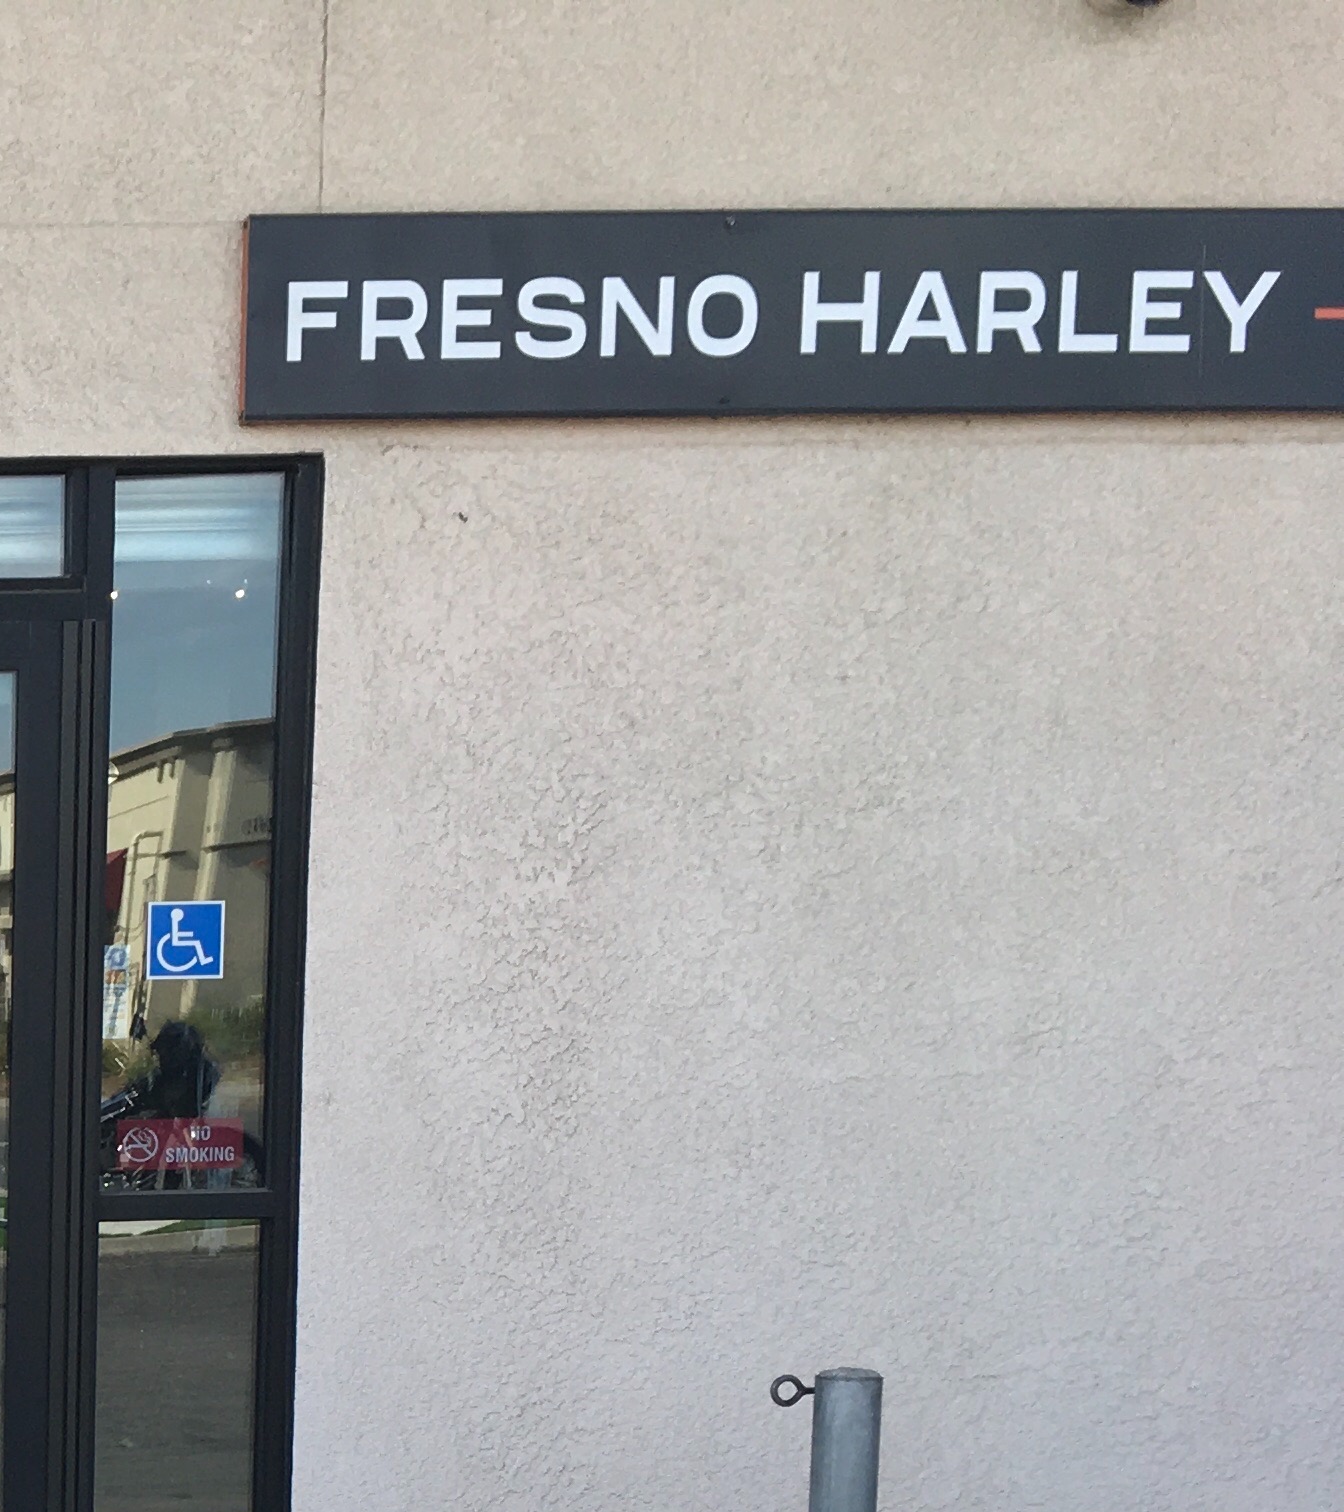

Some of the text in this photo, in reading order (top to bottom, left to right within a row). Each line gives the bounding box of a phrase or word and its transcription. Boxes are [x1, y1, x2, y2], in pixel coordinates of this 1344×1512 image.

[285, 270, 1281, 362] FRESNO HARLEY
[191, 1126, 211, 1141] NO
[165, 1146, 235, 1163] SMOKING
